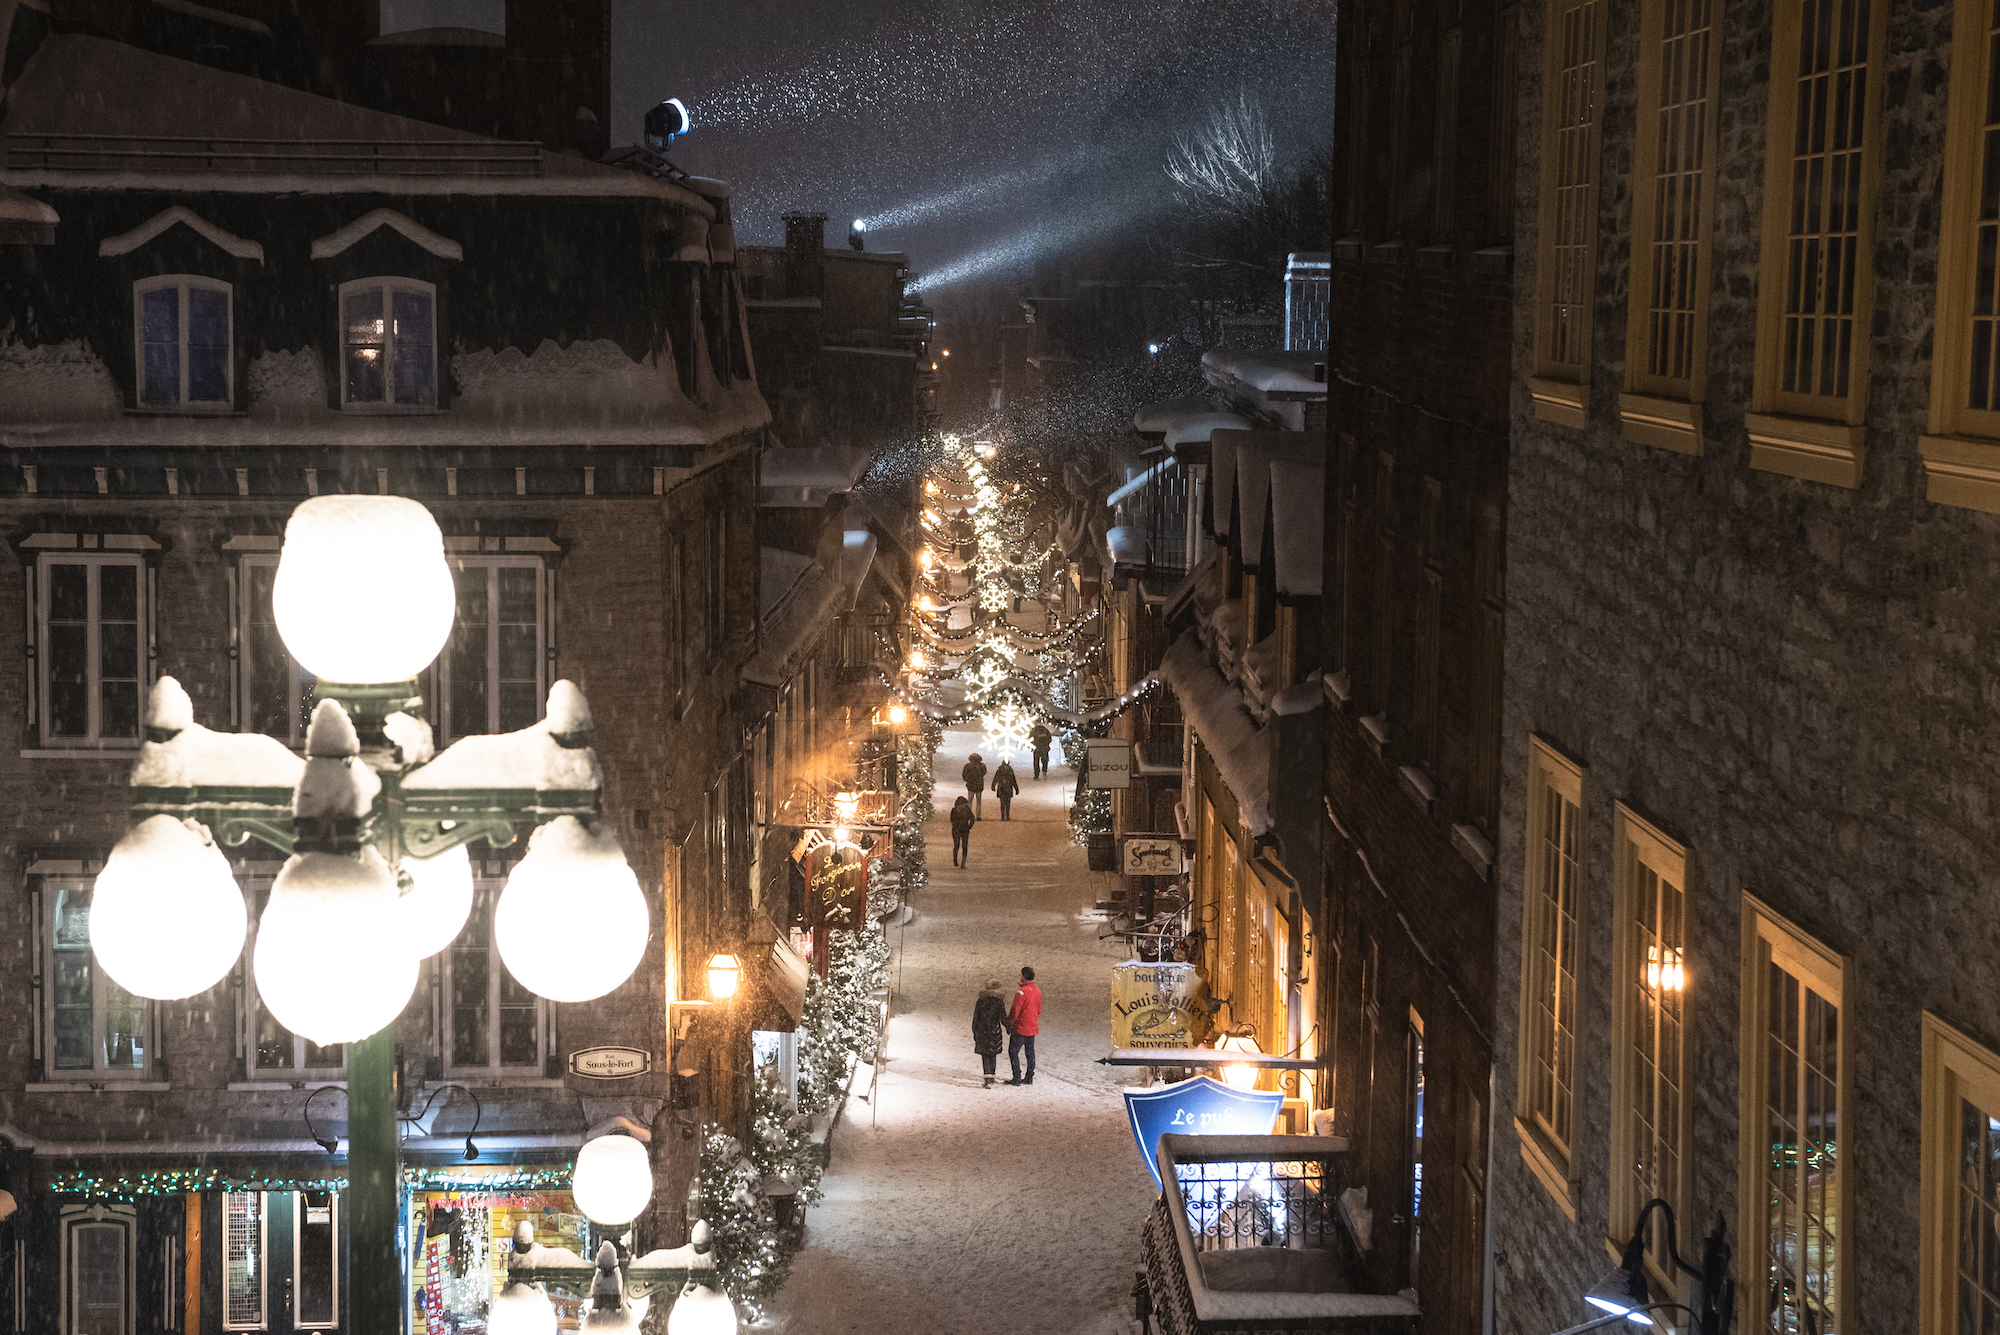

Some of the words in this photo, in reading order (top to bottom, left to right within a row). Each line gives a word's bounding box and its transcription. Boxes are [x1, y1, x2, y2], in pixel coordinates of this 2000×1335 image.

[1090, 757, 1128, 772] bizou
[1114, 992, 1160, 1019] Louis
[1129, 1038, 1189, 1049] souvenirs
[585, 1060, 634, 1069] Sous-le-Fort
[1170, 1108, 1195, 1126] Le
[1200, 1107, 1234, 1129] pub
